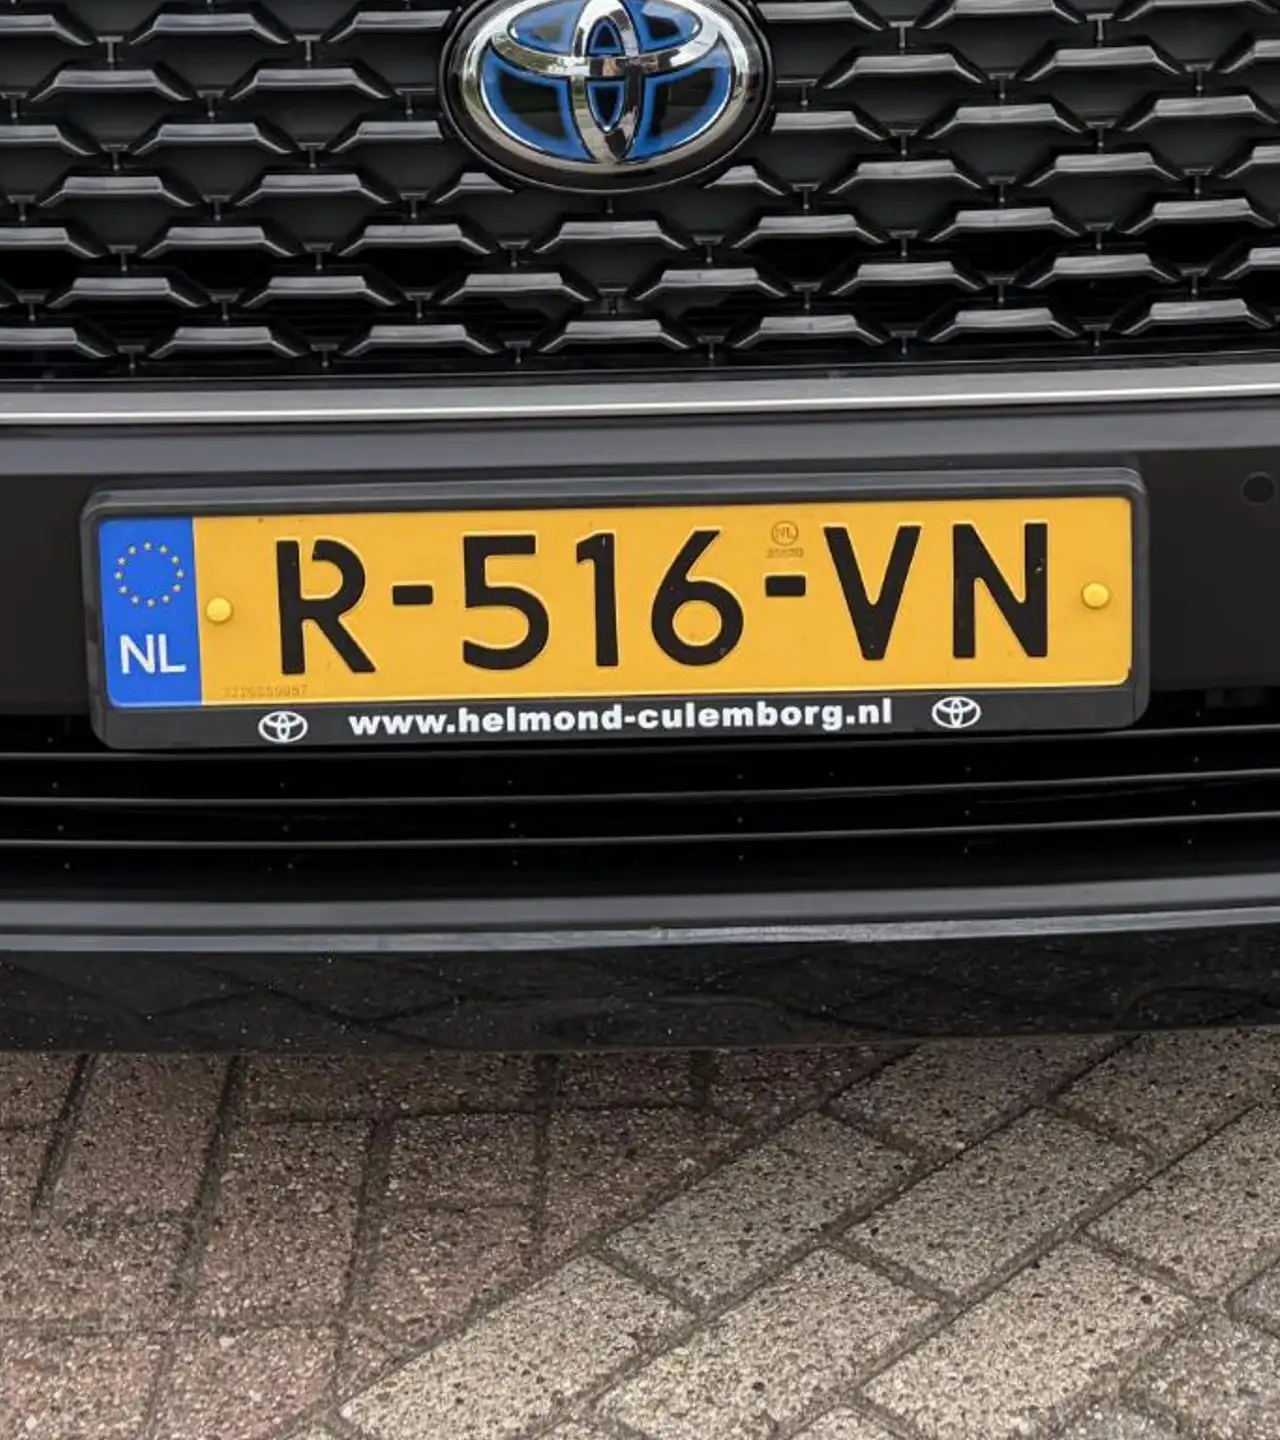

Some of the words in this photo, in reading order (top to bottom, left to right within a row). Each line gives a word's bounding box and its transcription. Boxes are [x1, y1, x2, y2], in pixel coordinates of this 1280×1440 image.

[276, 523, 1048, 675] R-516-VN
[120, 634, 186, 674] NL
[349, 698, 892, 735] www.helmond-culemborg.nl
